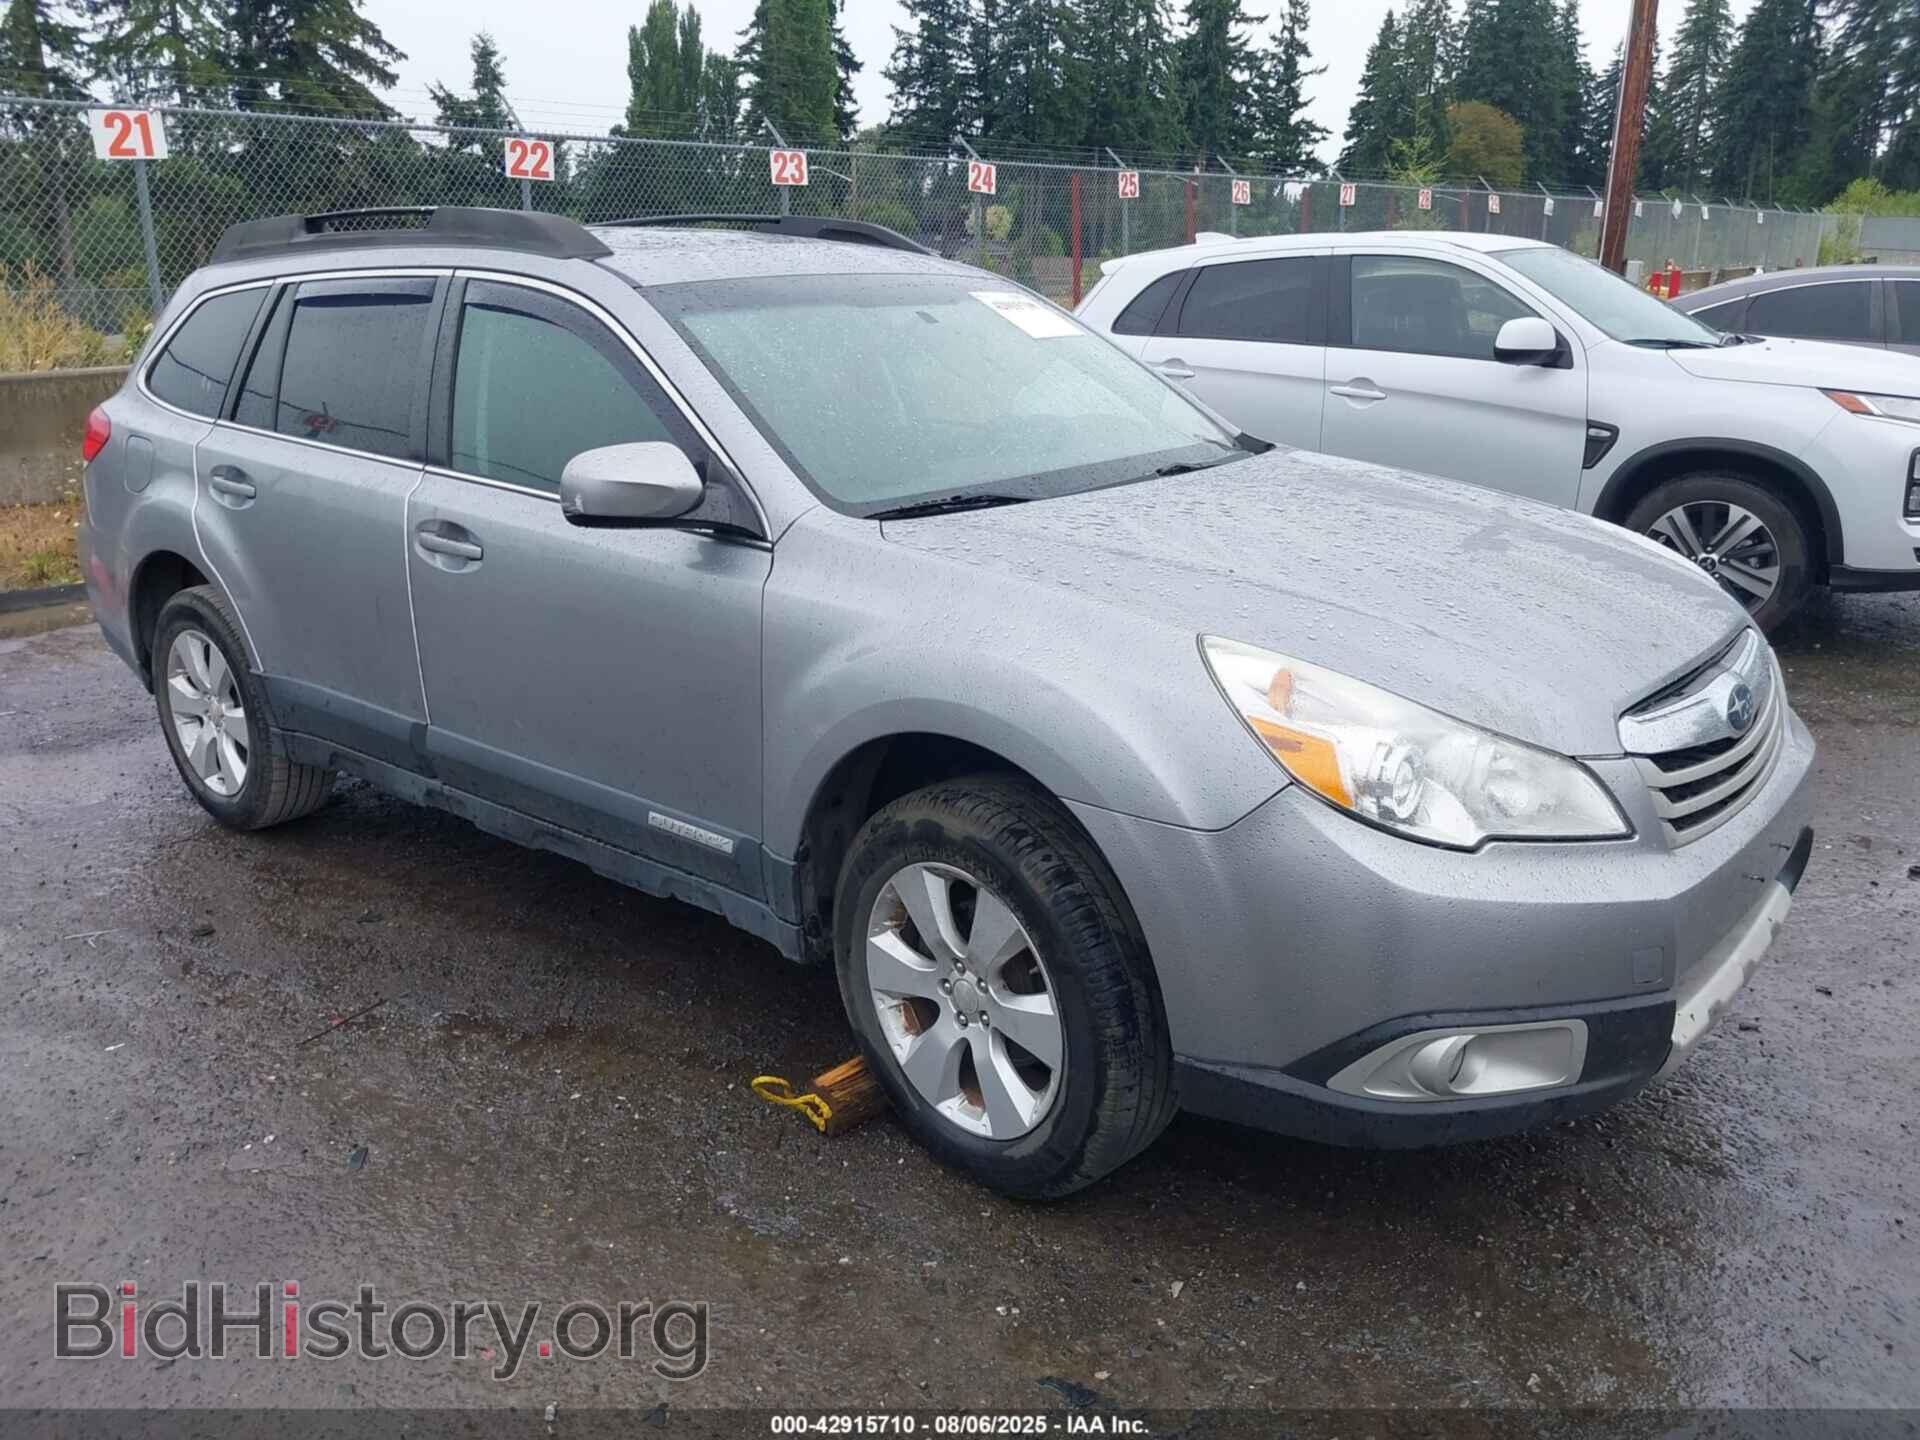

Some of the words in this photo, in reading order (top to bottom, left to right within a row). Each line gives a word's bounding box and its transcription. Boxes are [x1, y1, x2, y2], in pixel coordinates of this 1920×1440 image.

[103, 111, 154, 157] 21
[509, 140, 549, 178] 22
[774, 153, 805, 184] 23
[971, 164, 993, 192] 24
[1120, 174, 1136, 197] 25
[1233, 182, 1249, 202] 26
[1342, 185, 1353, 204] 27
